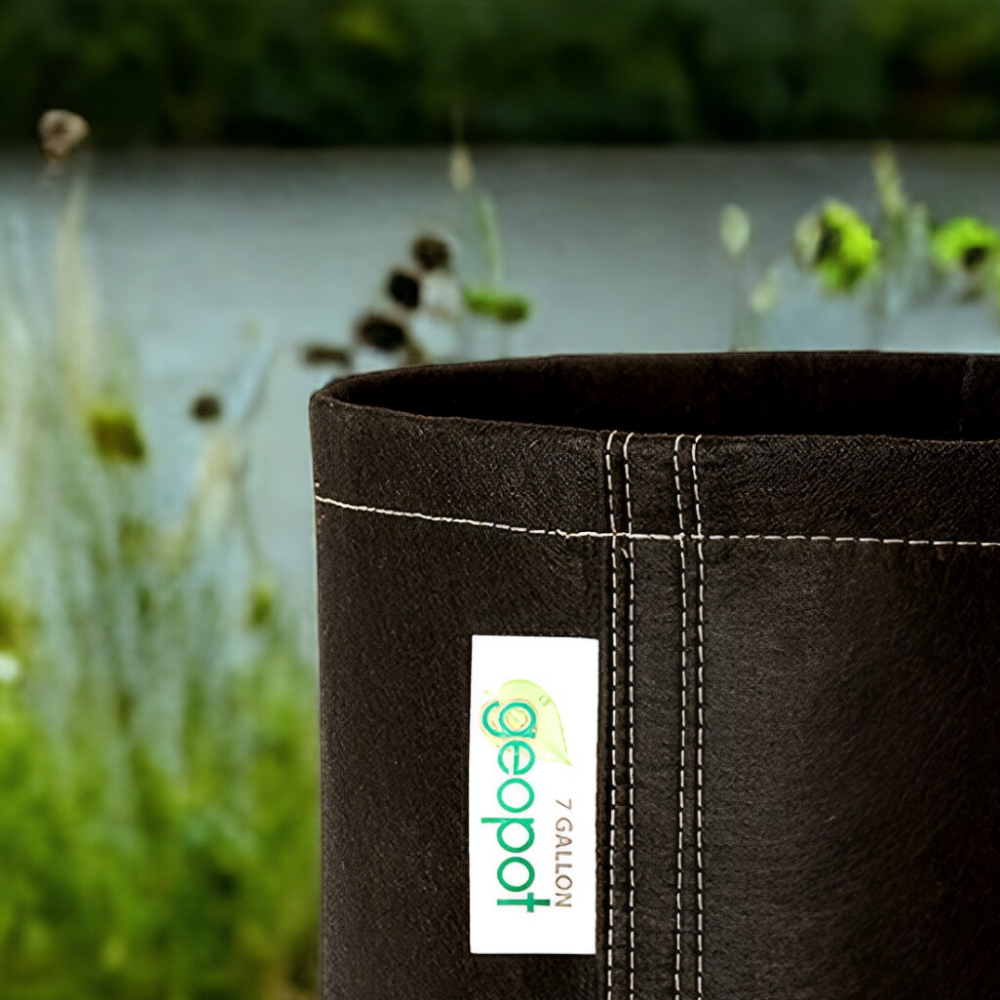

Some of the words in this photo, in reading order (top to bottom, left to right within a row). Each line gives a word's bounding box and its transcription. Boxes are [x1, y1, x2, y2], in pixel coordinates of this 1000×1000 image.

[481, 700, 551, 913] geopot
[555, 798, 573, 811] 7
[555, 817, 574, 908] GALLON
